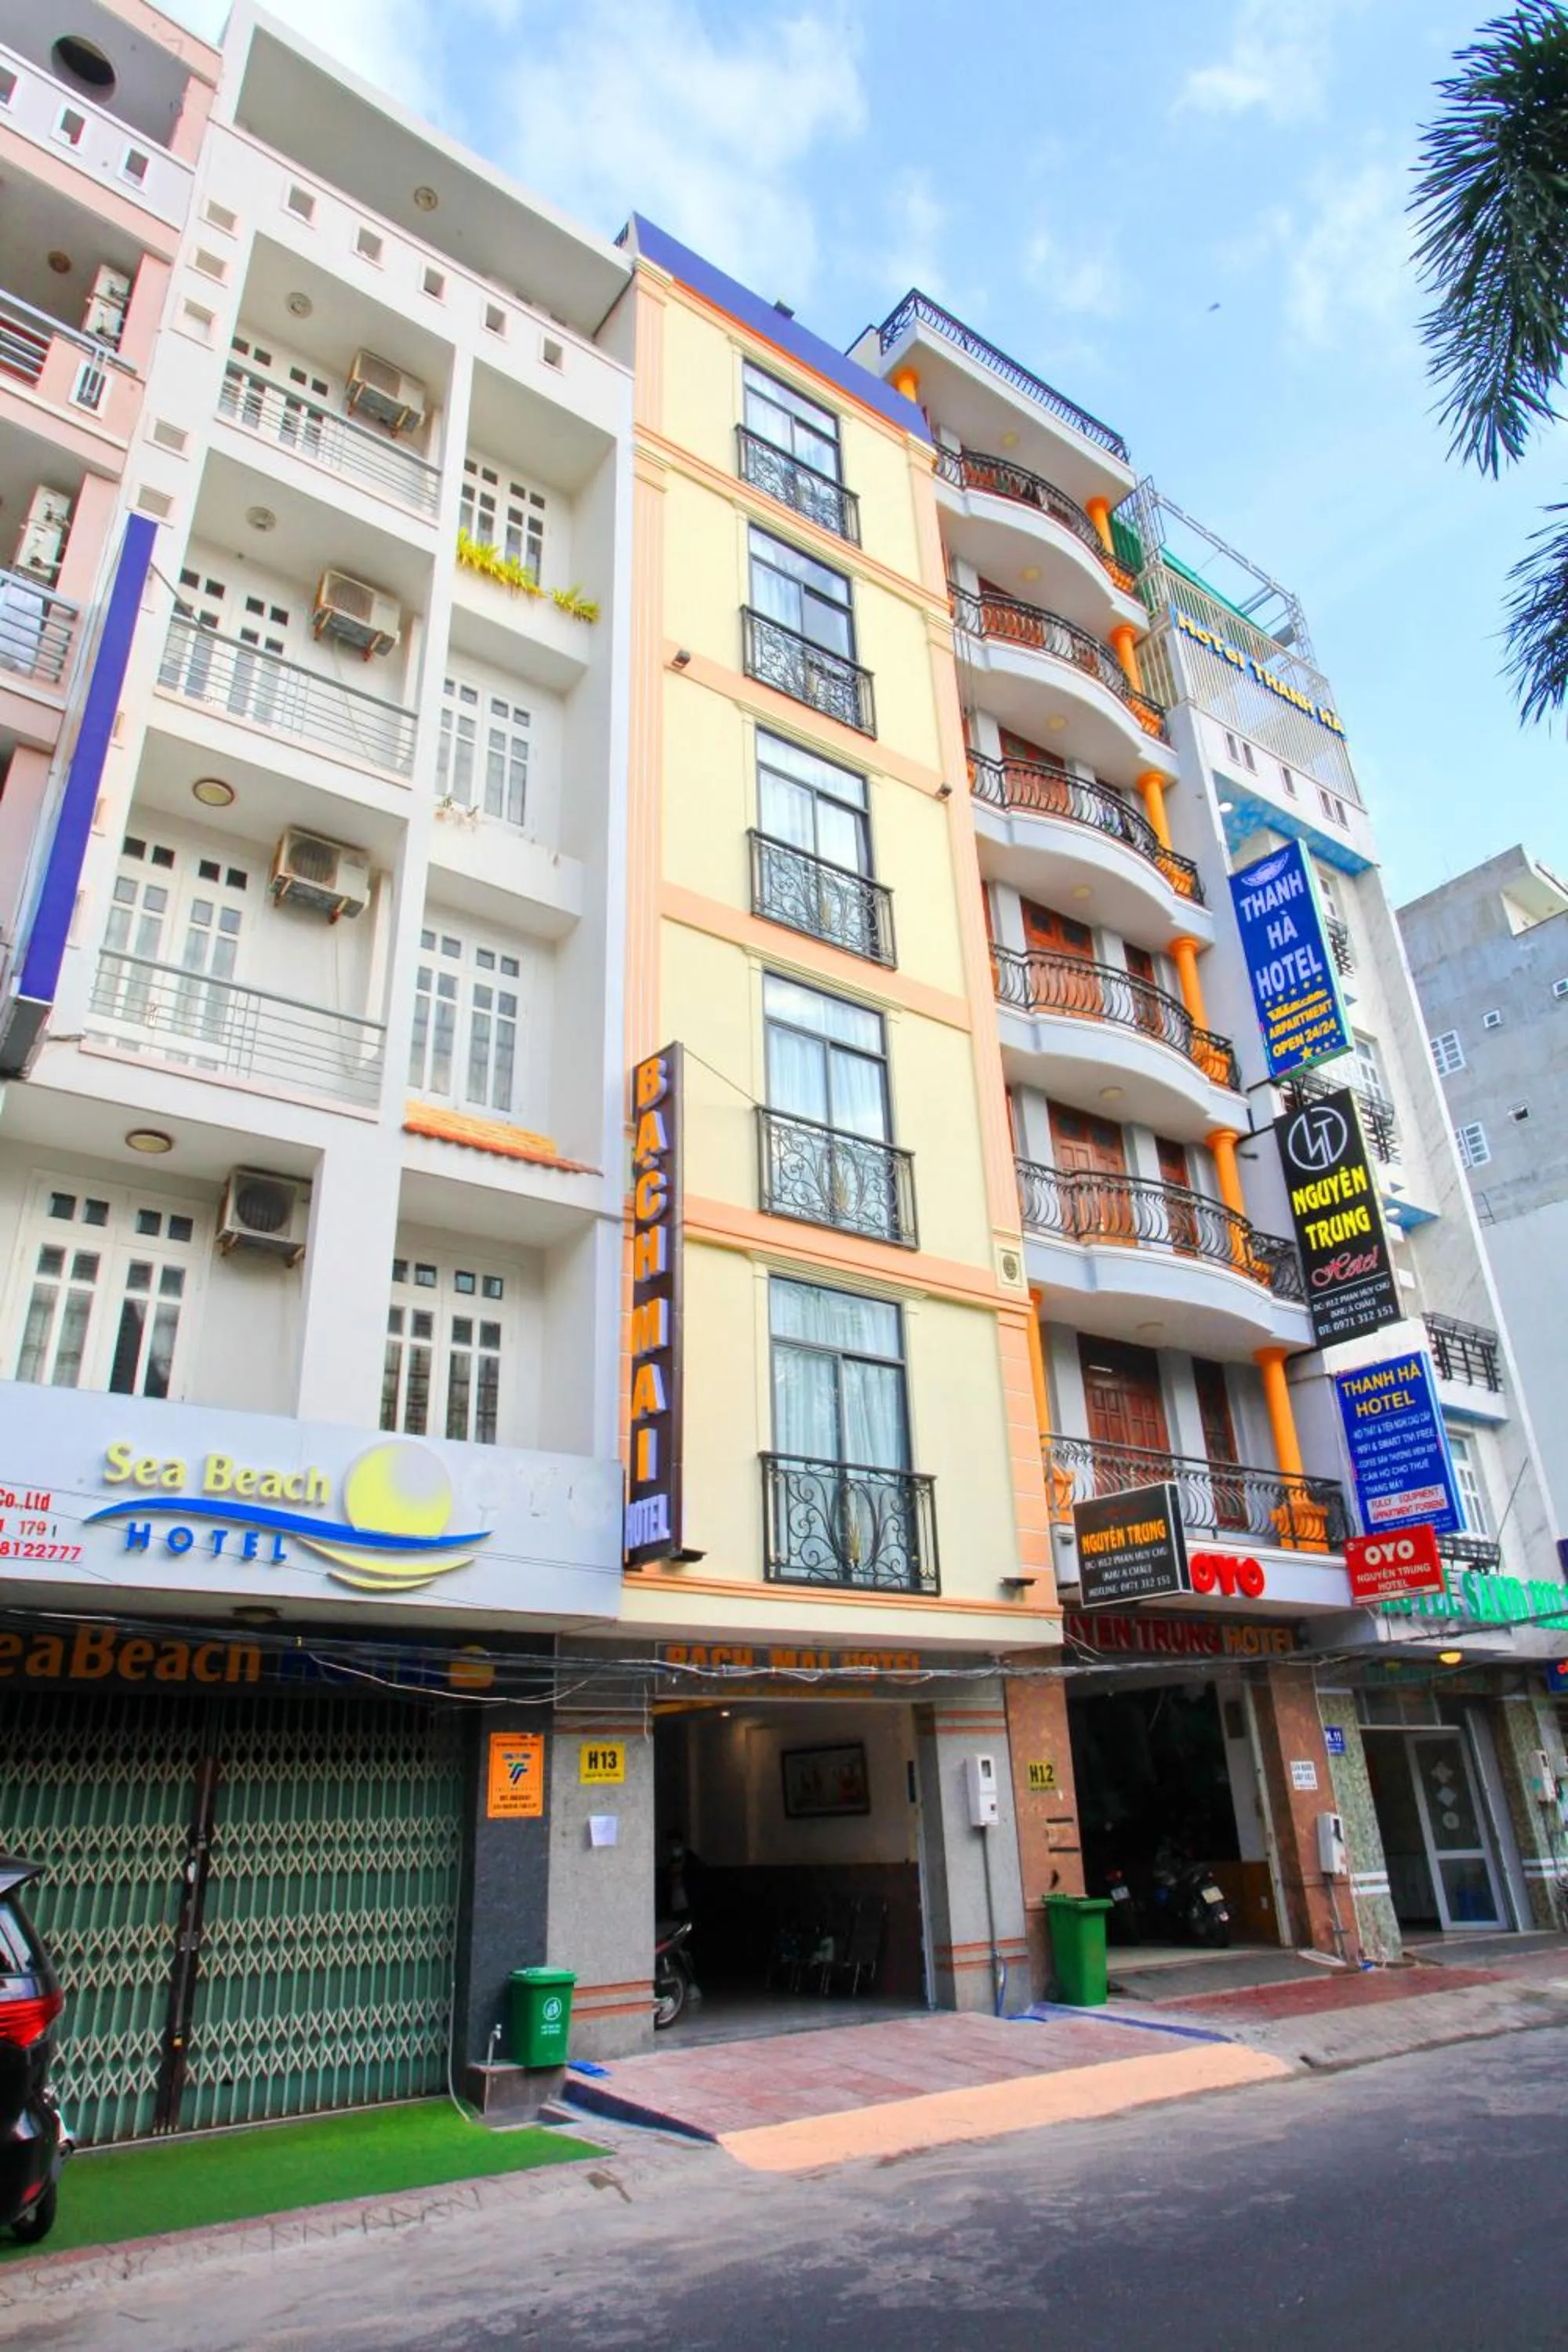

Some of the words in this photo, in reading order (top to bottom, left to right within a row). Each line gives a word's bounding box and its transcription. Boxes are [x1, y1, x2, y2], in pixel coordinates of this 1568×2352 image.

[1240, 869, 1304, 922] THANH
[1267, 910, 1298, 950] HÀ
[1256, 944, 1323, 1000] HOTEL
[1272, 1033, 1305, 1058] OPEN
[1305, 1206, 1371, 1251] TRUNG
[1311, 1245, 1378, 1287] Hotel
[1341, 1370, 1396, 1399] THANH
[1397, 1359, 1422, 1383] HÀ
[1355, 1389, 1417, 1418] HOTEL
[103, 1442, 187, 1492] Sea
[202, 1452, 332, 1506] Beach
[626, 1494, 671, 1550] HOTEL
[1127, 1519, 1167, 1546] TRUNG
[125, 1521, 288, 1565] HOTEL
[1364, 1539, 1414, 1566] OYO
[1189, 1552, 1265, 1599] OYO
[1377, 1579, 1410, 1592] HOTEL
[1398, 1563, 1432, 1576] TRUNG
[588, 1749, 618, 1770] H13
[1029, 1763, 1054, 1783] H12
